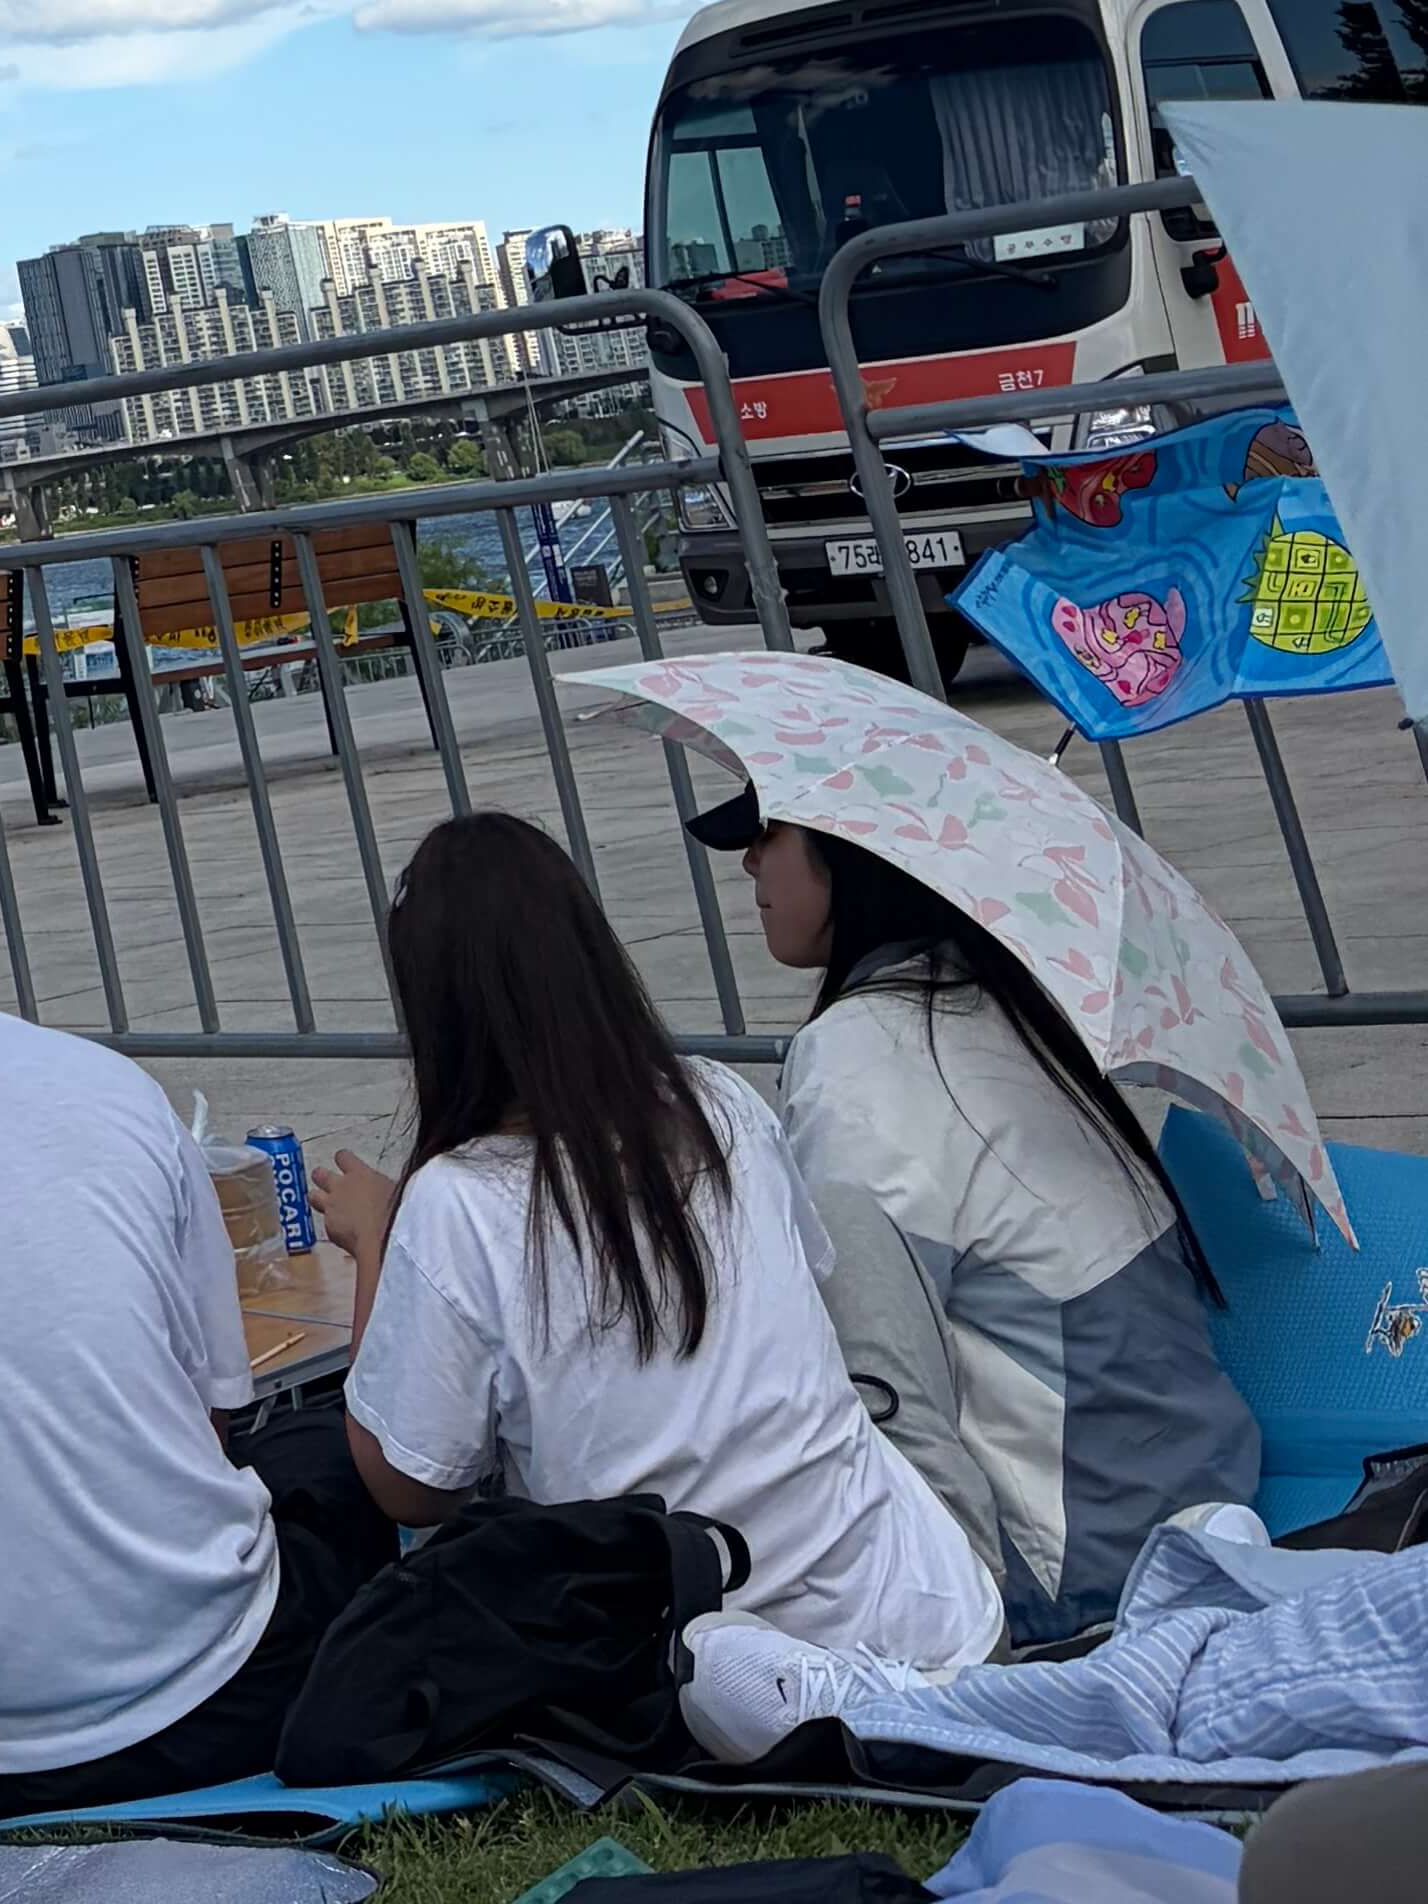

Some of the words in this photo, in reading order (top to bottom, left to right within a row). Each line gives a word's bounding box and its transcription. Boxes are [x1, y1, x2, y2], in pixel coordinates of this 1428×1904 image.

[998, 369, 1045, 392] 금천7
[740, 401, 767, 420] 소방
[905, 537, 948, 564] 841
[275, 1152, 305, 1249] POCARI
